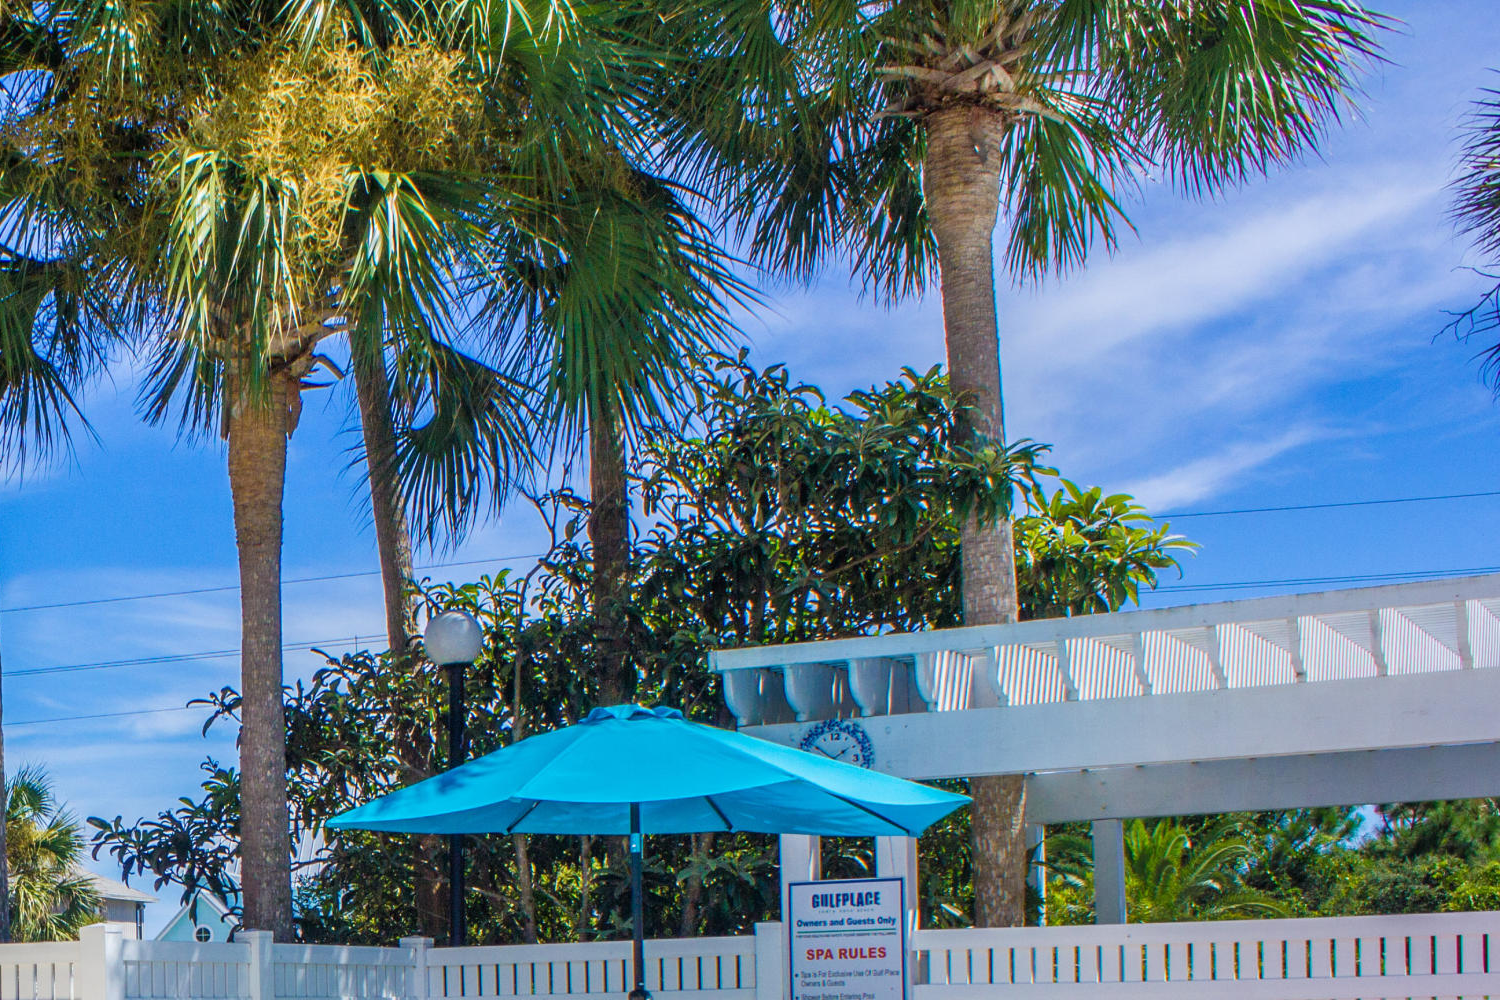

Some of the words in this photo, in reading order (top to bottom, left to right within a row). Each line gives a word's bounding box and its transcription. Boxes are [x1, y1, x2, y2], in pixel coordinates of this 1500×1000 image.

[811, 891, 881, 909] GULFPLACE
[796, 919, 827, 927] Owners
[829, 918, 844, 926] and
[846, 917, 875, 926] Guests
[877, 916, 897, 926] Only
[806, 948, 834, 960] SPA
[838, 946, 887, 960] RULES
